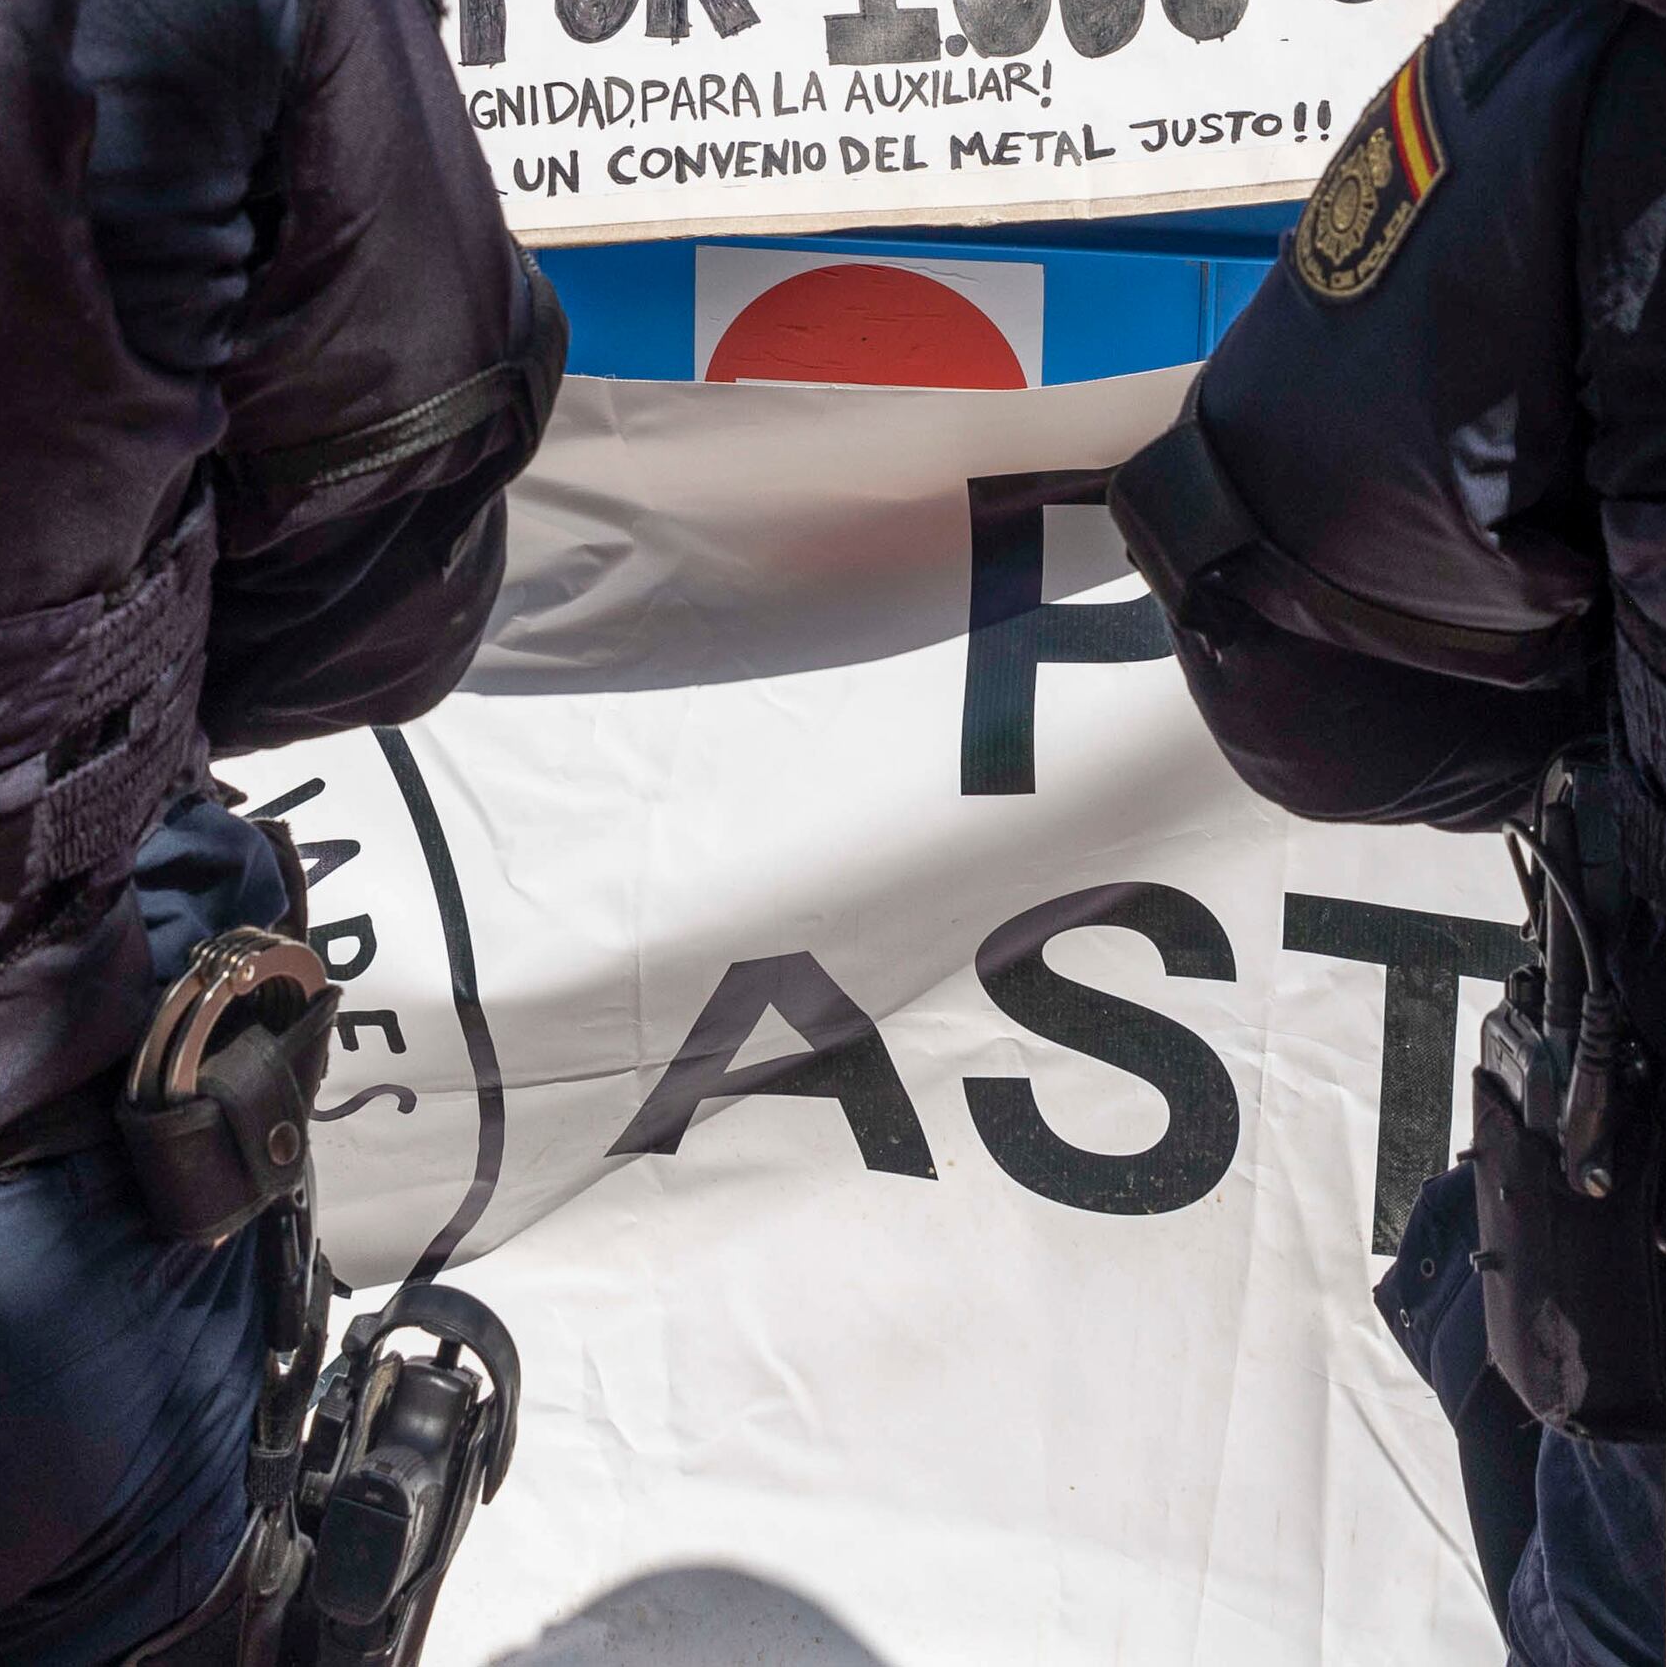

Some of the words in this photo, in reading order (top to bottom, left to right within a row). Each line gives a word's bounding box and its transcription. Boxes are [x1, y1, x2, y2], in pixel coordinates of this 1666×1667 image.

[773, 71, 827, 117] LA
[844, 60, 1053, 113] AUXILIAR!
[513, 149, 580, 198] UN
[607, 138, 827, 185] CONVENIO
[838, 134, 929, 175] DEL
[950, 124, 1116, 170] METAL
[1128, 99, 1332, 153] JUSTO!!
